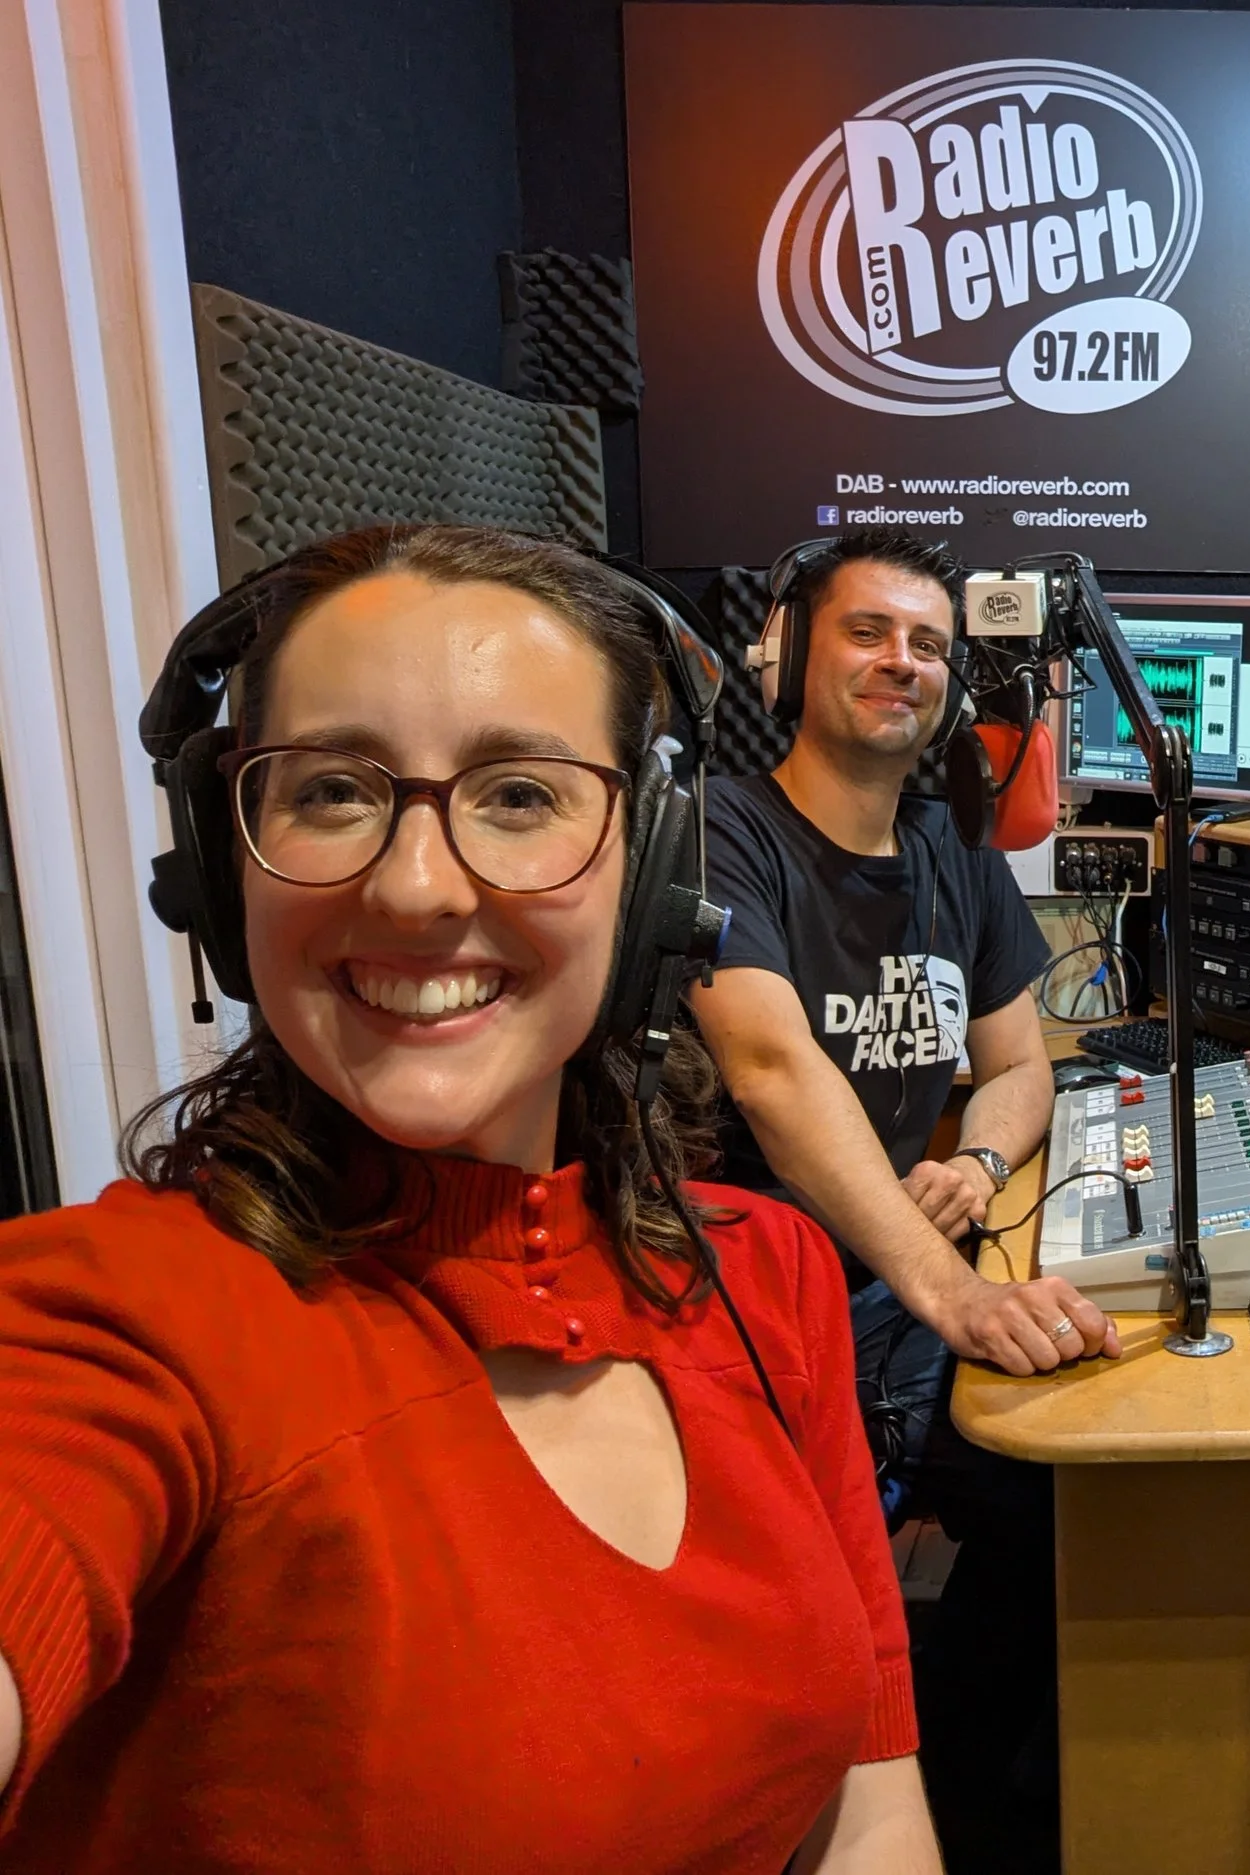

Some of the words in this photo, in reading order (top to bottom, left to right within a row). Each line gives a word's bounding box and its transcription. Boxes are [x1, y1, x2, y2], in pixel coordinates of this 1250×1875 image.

[843, 105, 1100, 236] Radio
[866, 245, 894, 340] .com
[836, 474, 884, 494] DAB
[901, 475, 1130, 496] www.radioreverb.com
[847, 507, 964, 525] radioreverb
[1013, 509, 1147, 528] @radioreverb
[850, 1027, 937, 1072] FACE
